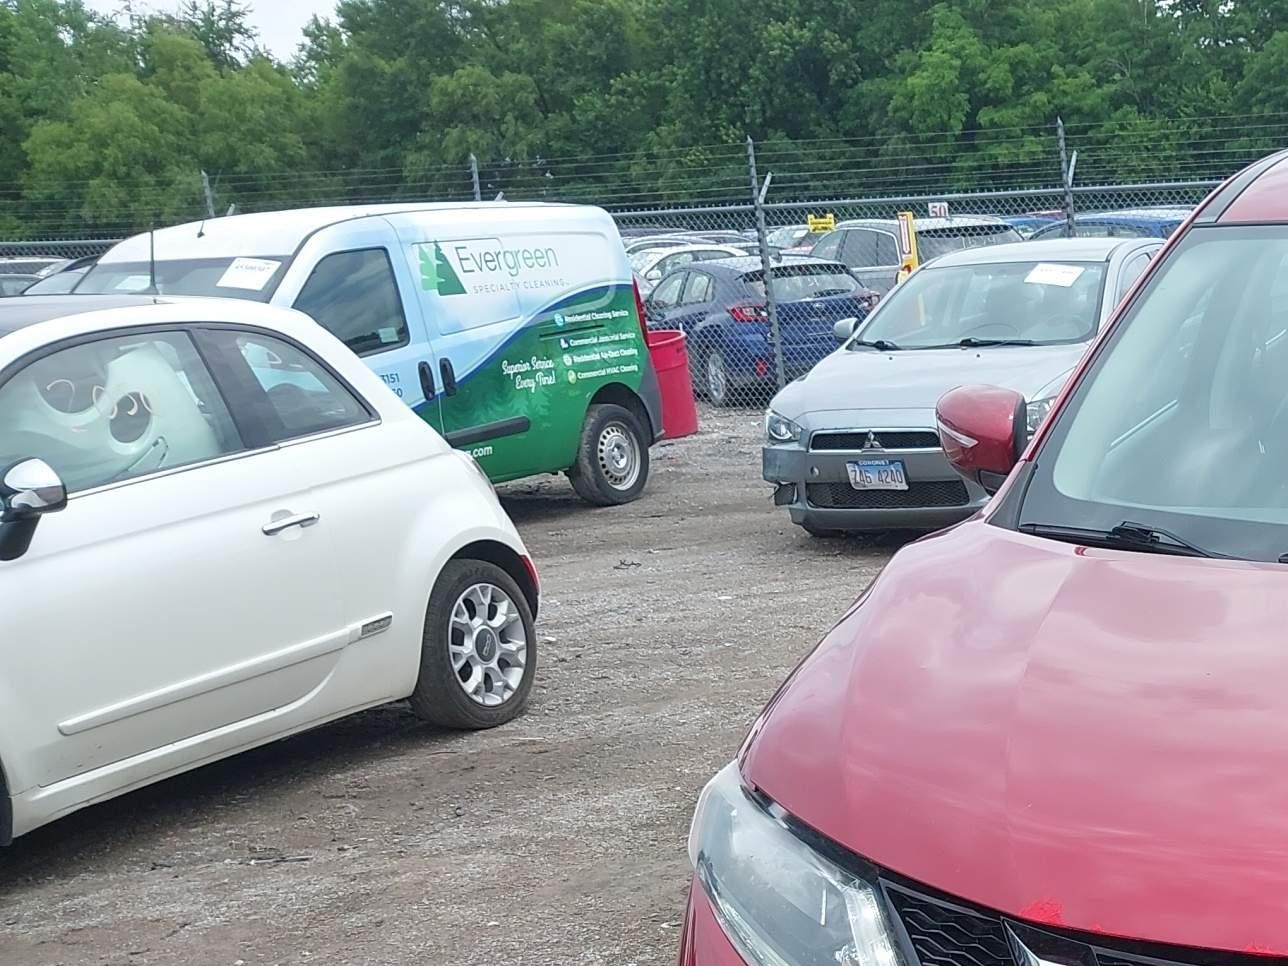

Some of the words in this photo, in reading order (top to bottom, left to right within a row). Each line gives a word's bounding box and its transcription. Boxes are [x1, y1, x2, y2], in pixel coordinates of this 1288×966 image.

[455, 245, 559, 277] Evergreen
[473, 281, 520, 294] SPECIALTY
[523, 278, 565, 289] CLEANING
[565, 313, 591, 322] Residential
[569, 336, 598, 346] Commercial
[619, 332, 636, 340] Service
[573, 353, 600, 362] Residential
[620, 348, 638, 356] Cleaning
[501, 360, 531, 379] Superior
[531, 356, 555, 370] Service
[577, 369, 606, 379] Commercial
[607, 366, 620, 375] HVAC
[620, 365, 638, 373] Cleaning
[515, 375, 536, 393] Every
[535, 370, 556, 386] Time!
[877, 469, 903, 484] 4240
